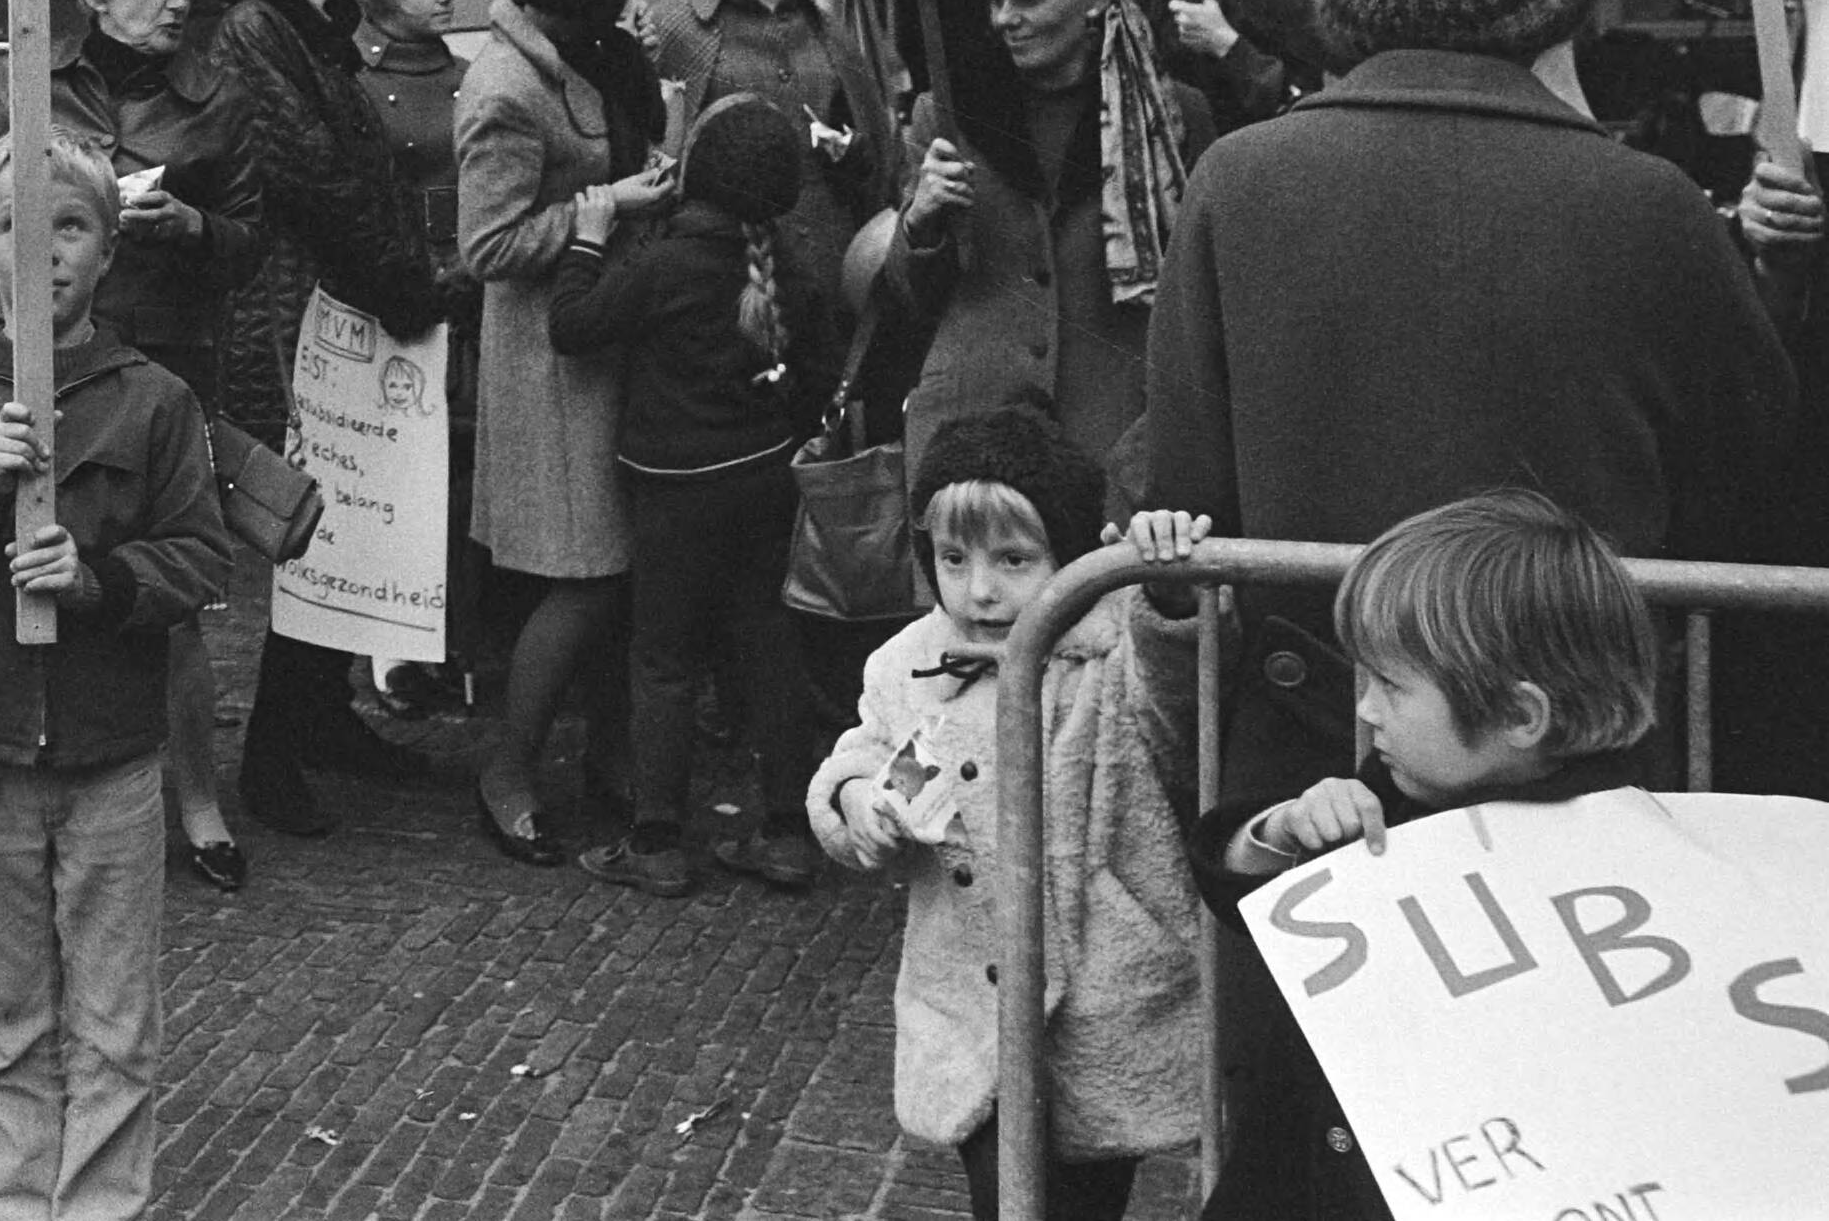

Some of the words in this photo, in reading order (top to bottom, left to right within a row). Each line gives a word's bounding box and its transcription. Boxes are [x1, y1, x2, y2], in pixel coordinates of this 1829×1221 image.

[334, 480, 395, 525] belang
[1268, 867, 1829, 1095] SUBS
[1393, 1116, 1546, 1206] VER
